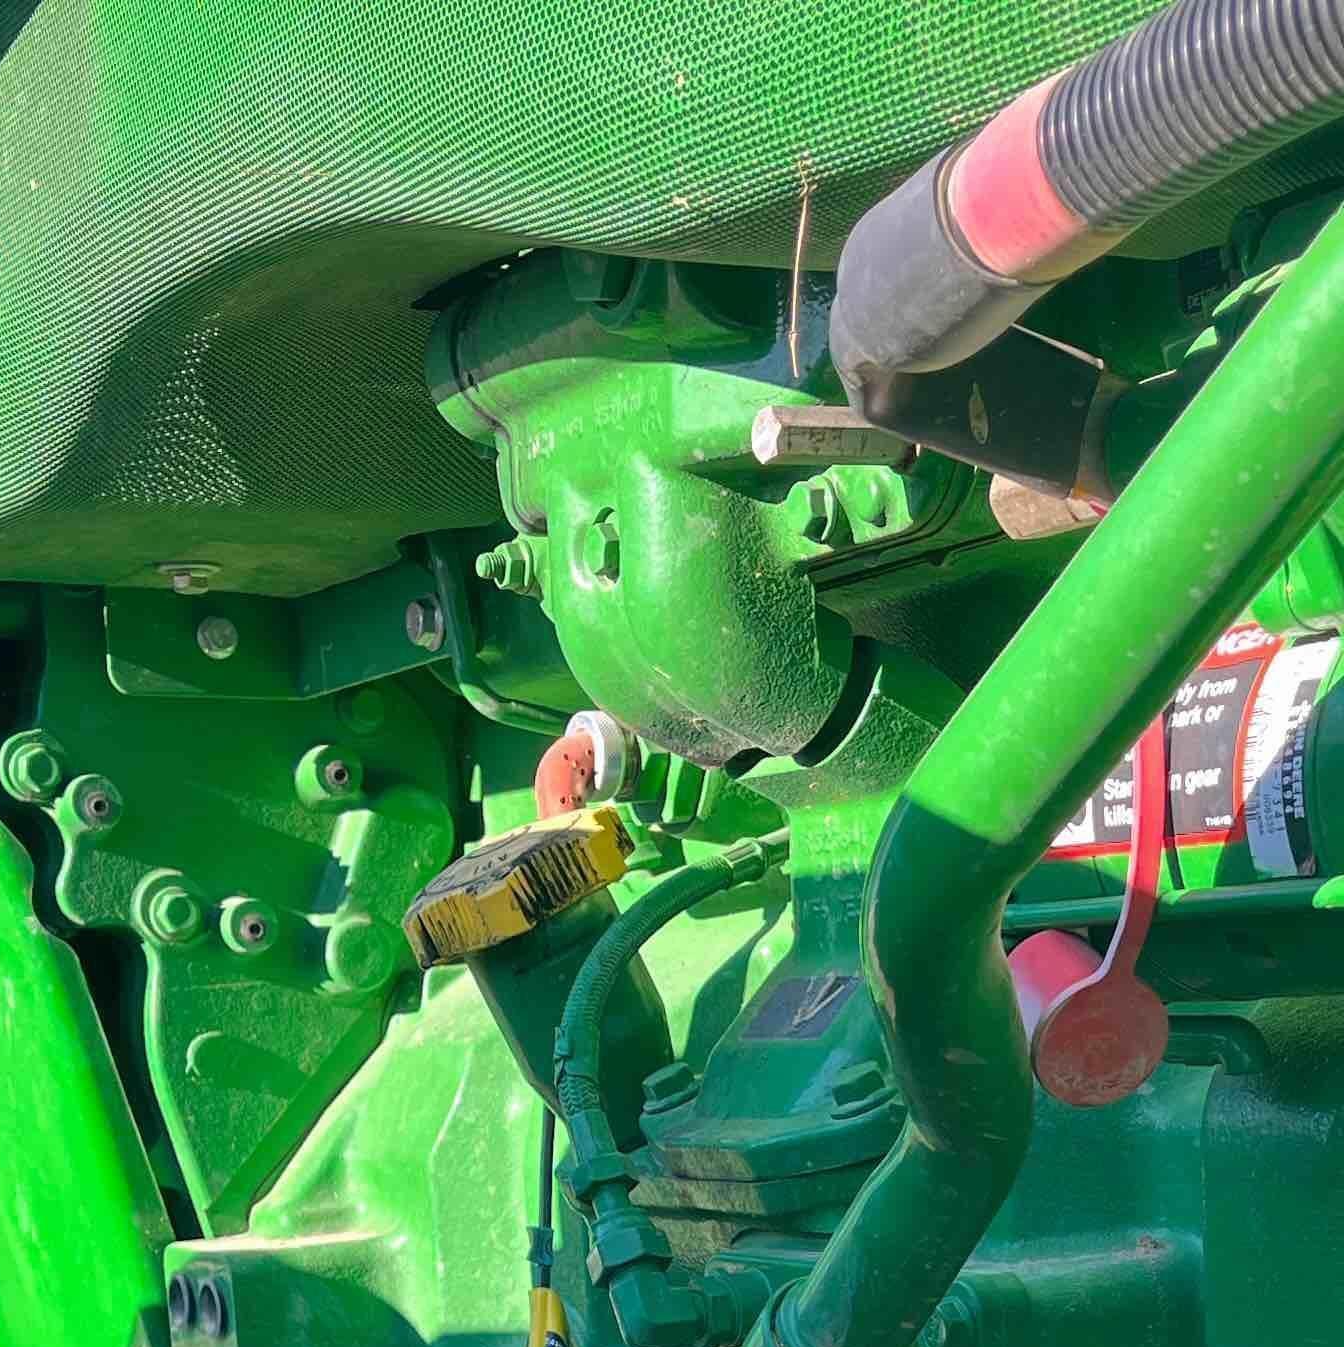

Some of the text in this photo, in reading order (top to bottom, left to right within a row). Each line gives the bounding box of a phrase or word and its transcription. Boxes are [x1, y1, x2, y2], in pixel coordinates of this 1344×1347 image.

[1197, 678, 1238, 699] from
[1204, 704, 1225, 723] or
[1184, 767, 1222, 795] gear
[1292, 755, 1305, 819] DEERE
